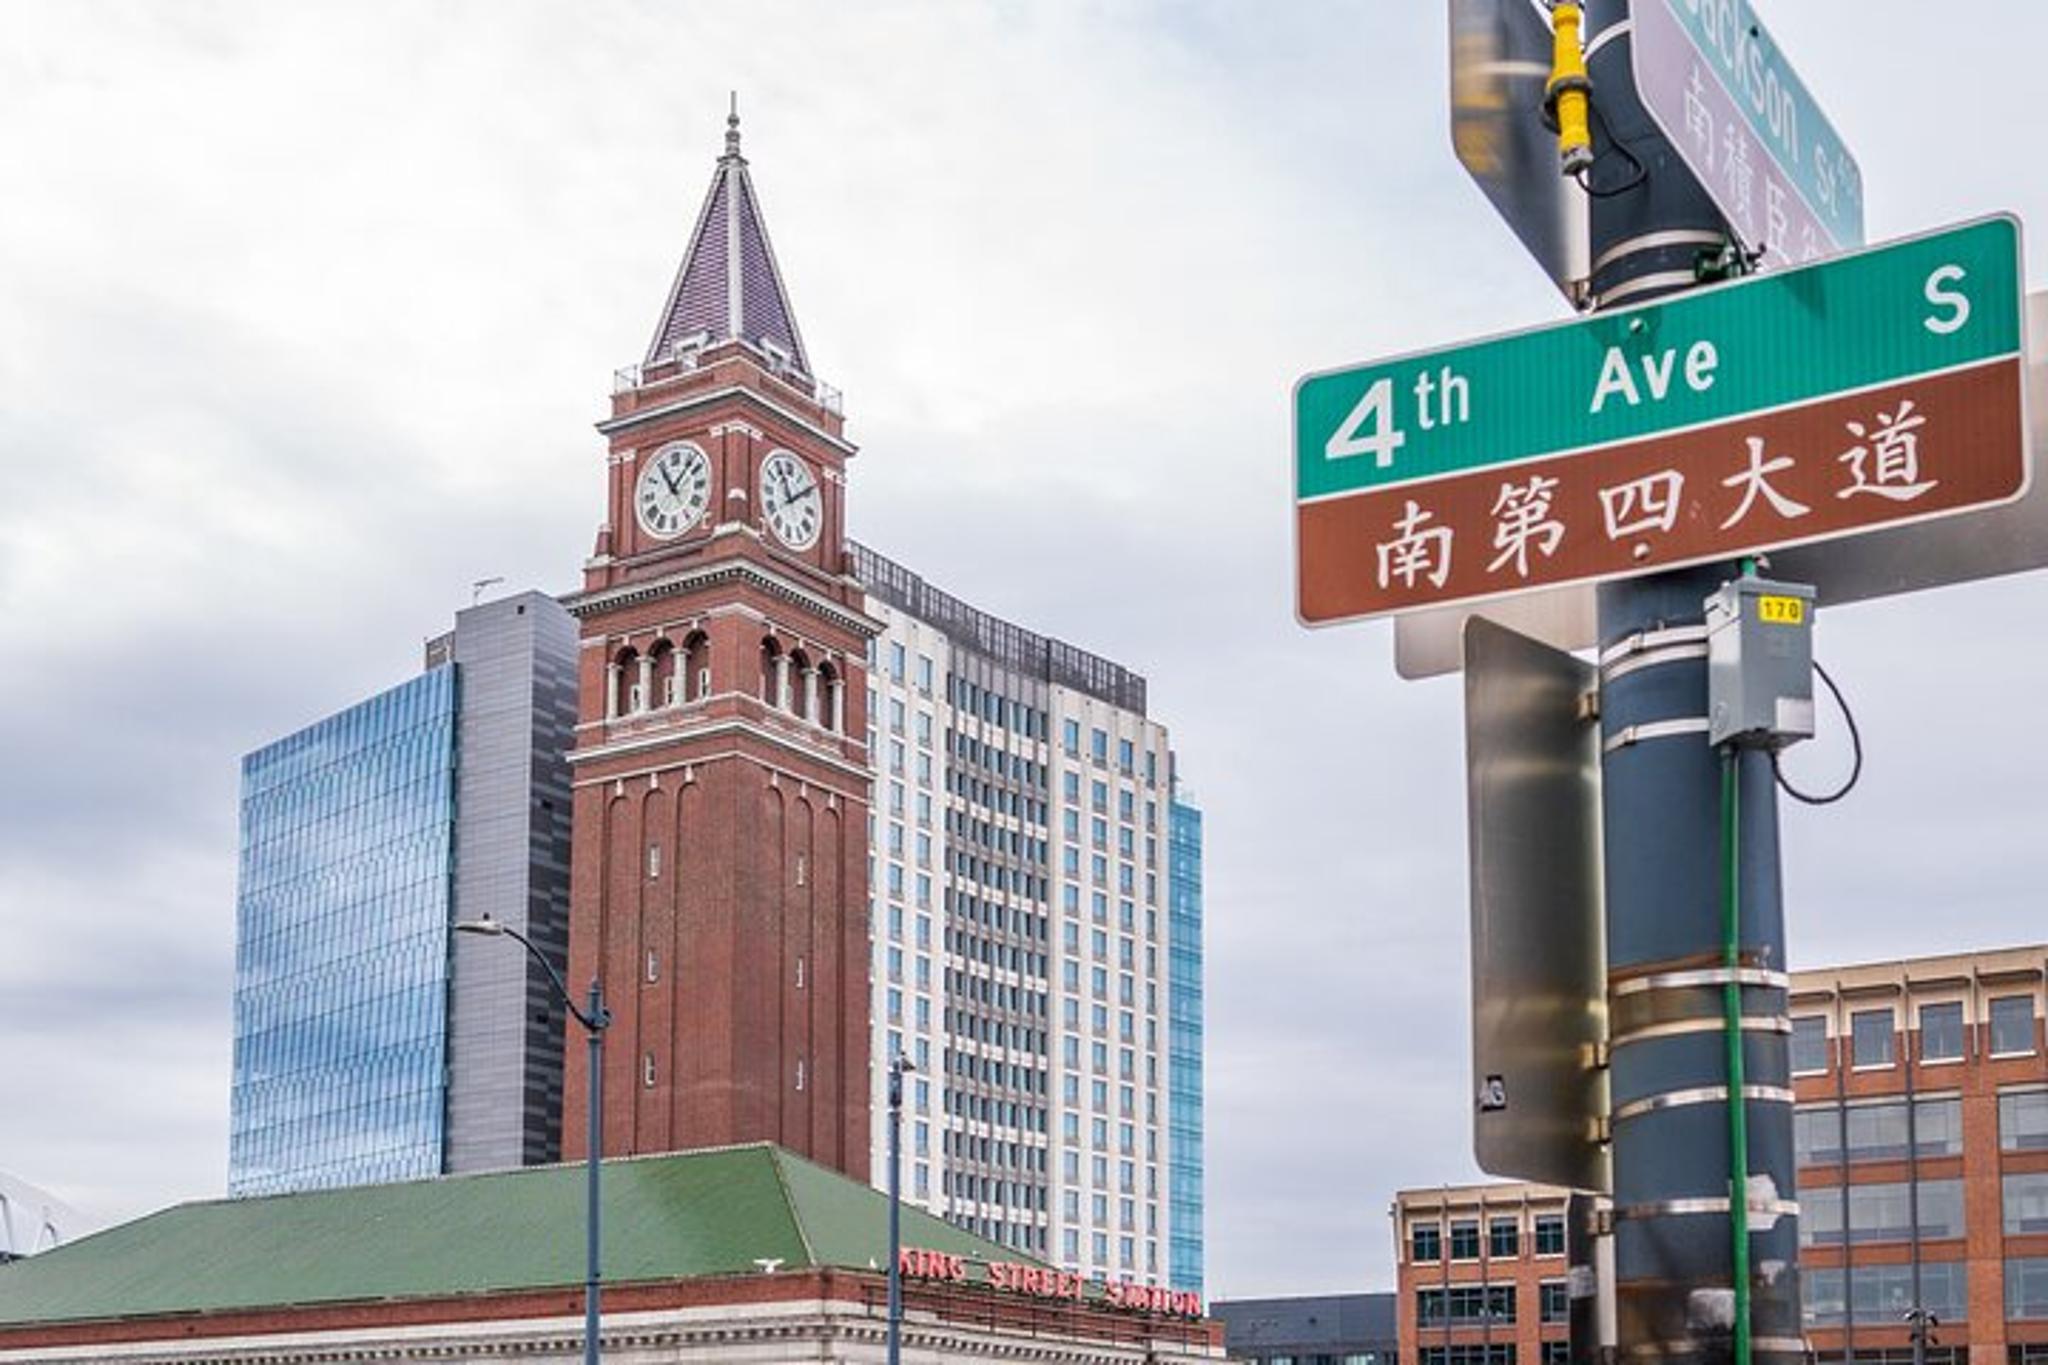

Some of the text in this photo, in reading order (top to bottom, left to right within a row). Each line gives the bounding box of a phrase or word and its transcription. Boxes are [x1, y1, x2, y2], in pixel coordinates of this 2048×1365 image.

[1684, 0, 1799, 164] ackson
[1325, 264, 1970, 468] 4th Ave S
[1376, 401, 1939, 590] 南第四大道
[1763, 602, 1800, 618] 170
[899, 1247, 1201, 1315] KING STREET STATION
